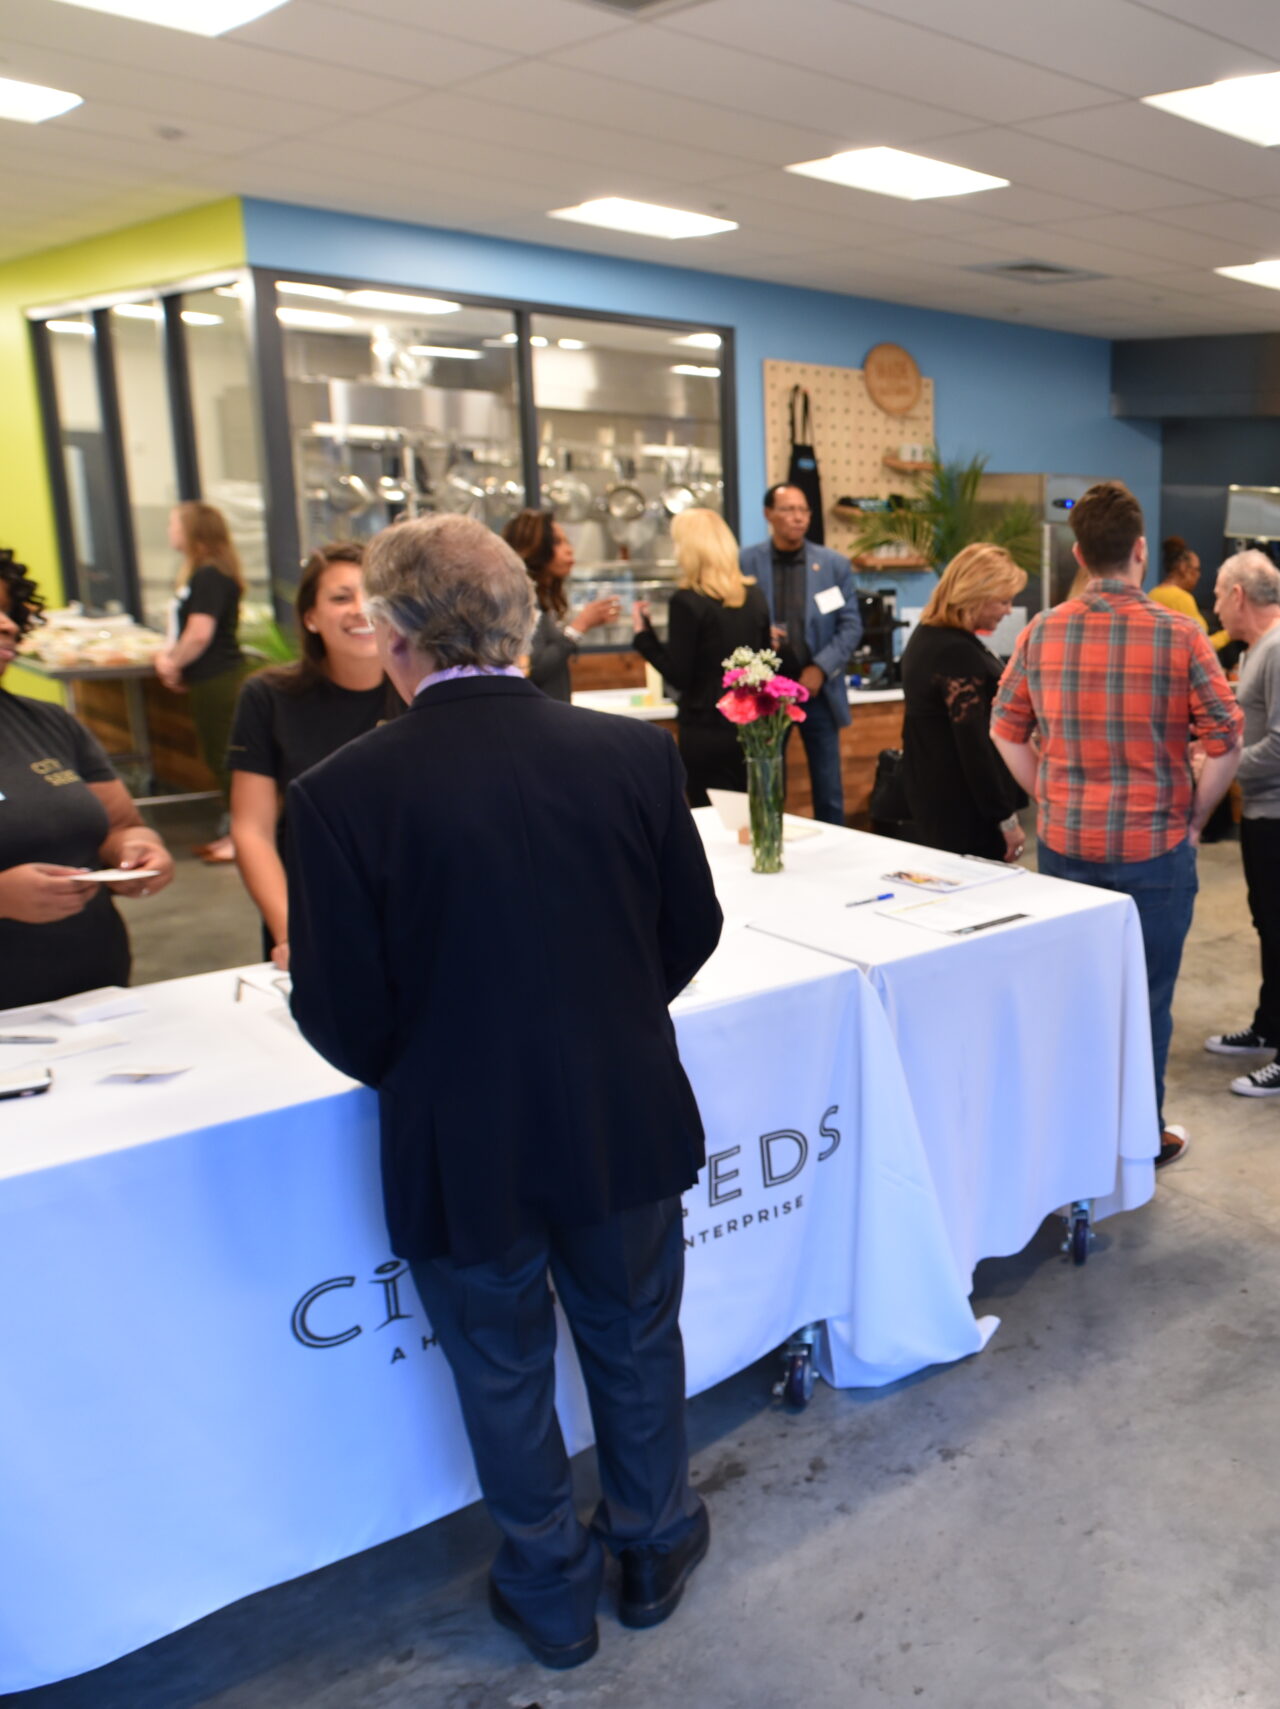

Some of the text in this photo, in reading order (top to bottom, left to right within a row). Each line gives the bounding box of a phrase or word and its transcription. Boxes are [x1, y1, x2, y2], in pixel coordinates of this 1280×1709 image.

[291, 1105, 842, 1348] Ci EDS
[390, 1195, 804, 1364] A NTERPRISE
